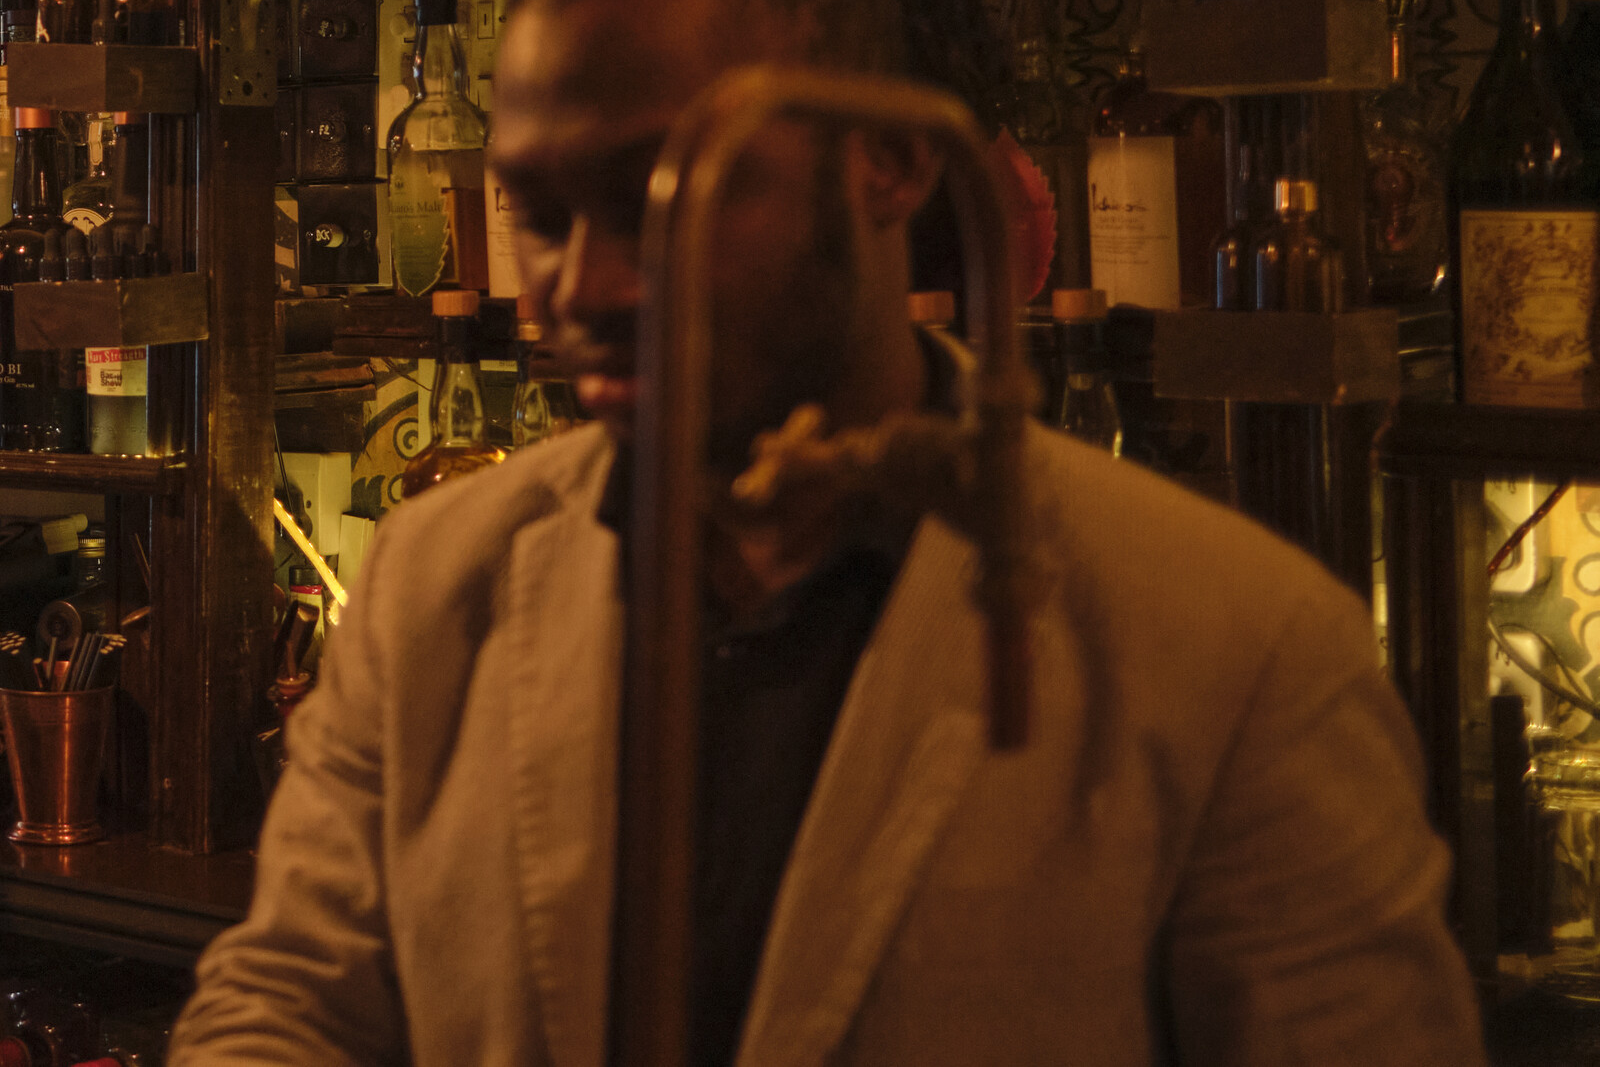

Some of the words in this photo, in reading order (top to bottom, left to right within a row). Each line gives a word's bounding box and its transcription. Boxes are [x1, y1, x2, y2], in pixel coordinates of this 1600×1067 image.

[417, 202, 442, 214] Malt
[104, 349, 144, 363] Strength
[7, 364, 21, 375] BI
[4, 375, 16, 383] Gin
